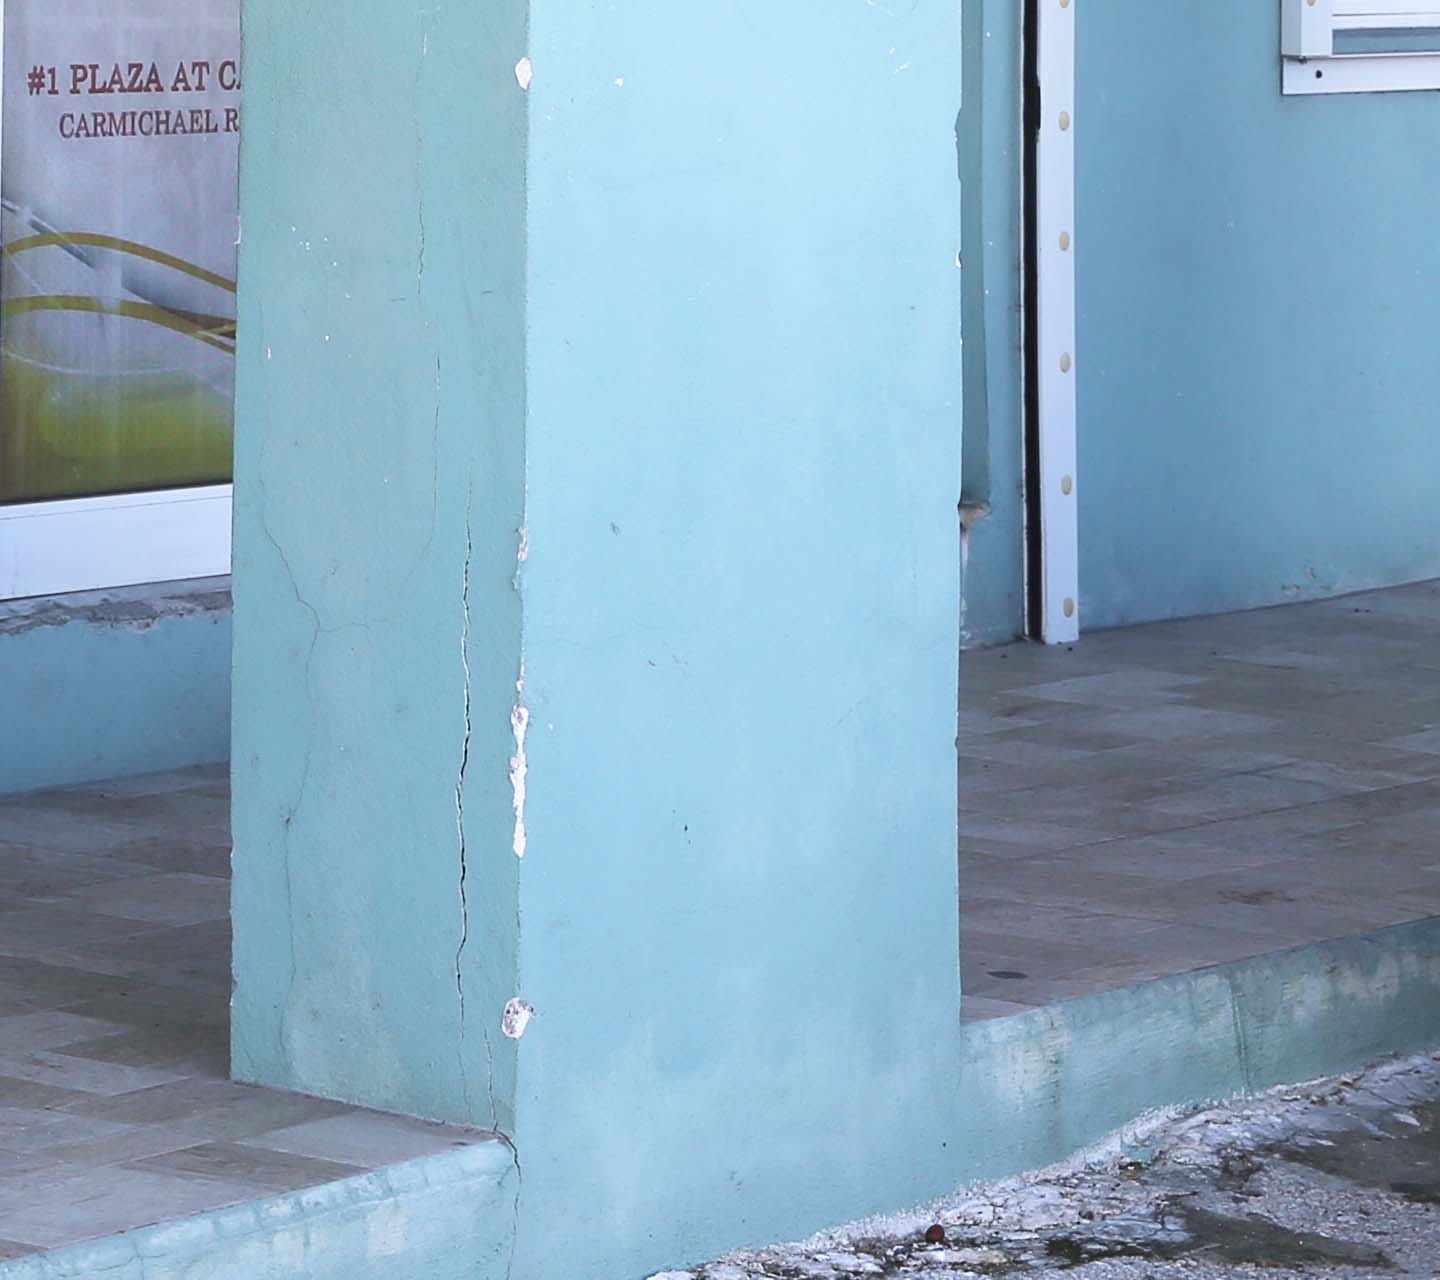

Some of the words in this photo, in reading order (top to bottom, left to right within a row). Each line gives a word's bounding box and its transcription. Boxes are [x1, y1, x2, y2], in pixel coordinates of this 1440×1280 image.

[27, 65, 59, 96] #1
[69, 62, 165, 94] PLAZA
[171, 60, 211, 92] AT
[218, 60, 241, 90] C
[59, 108, 219, 140] CARMICHAEL
